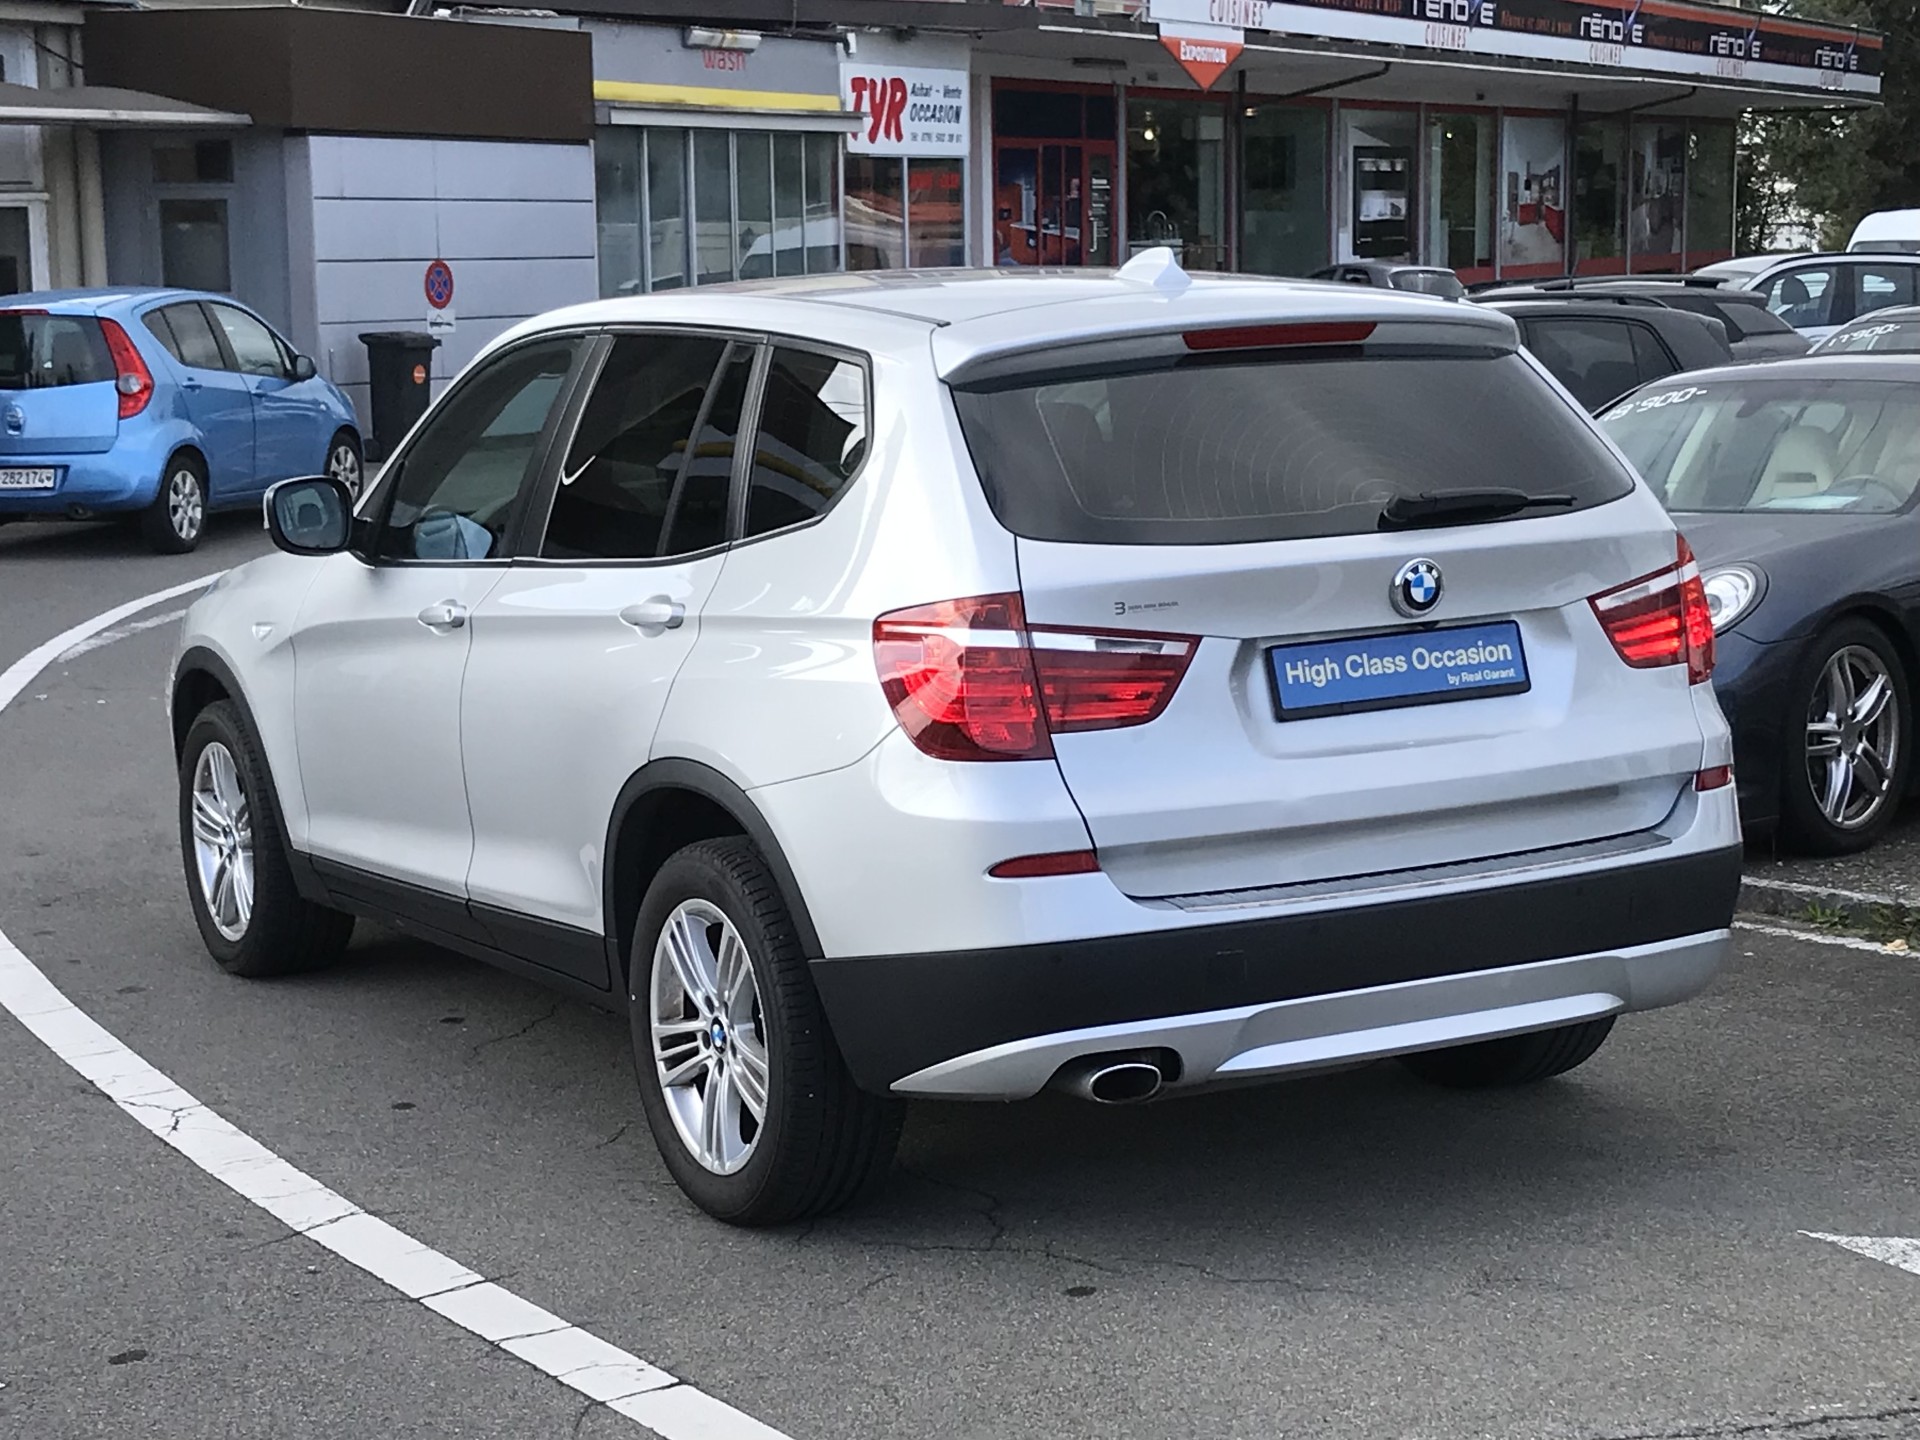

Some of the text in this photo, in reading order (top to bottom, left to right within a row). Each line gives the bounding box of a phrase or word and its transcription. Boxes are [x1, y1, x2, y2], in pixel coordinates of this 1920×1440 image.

[1208, 0, 1265, 27] CUISINES
[1424, 23, 1468, 49] CUISINES
[850, 77, 908, 145] TYR
[910, 103, 962, 124] OCCASION
[1285, 640, 1513, 688] High Class Occasion
[1447, 672, 1461, 686] by
